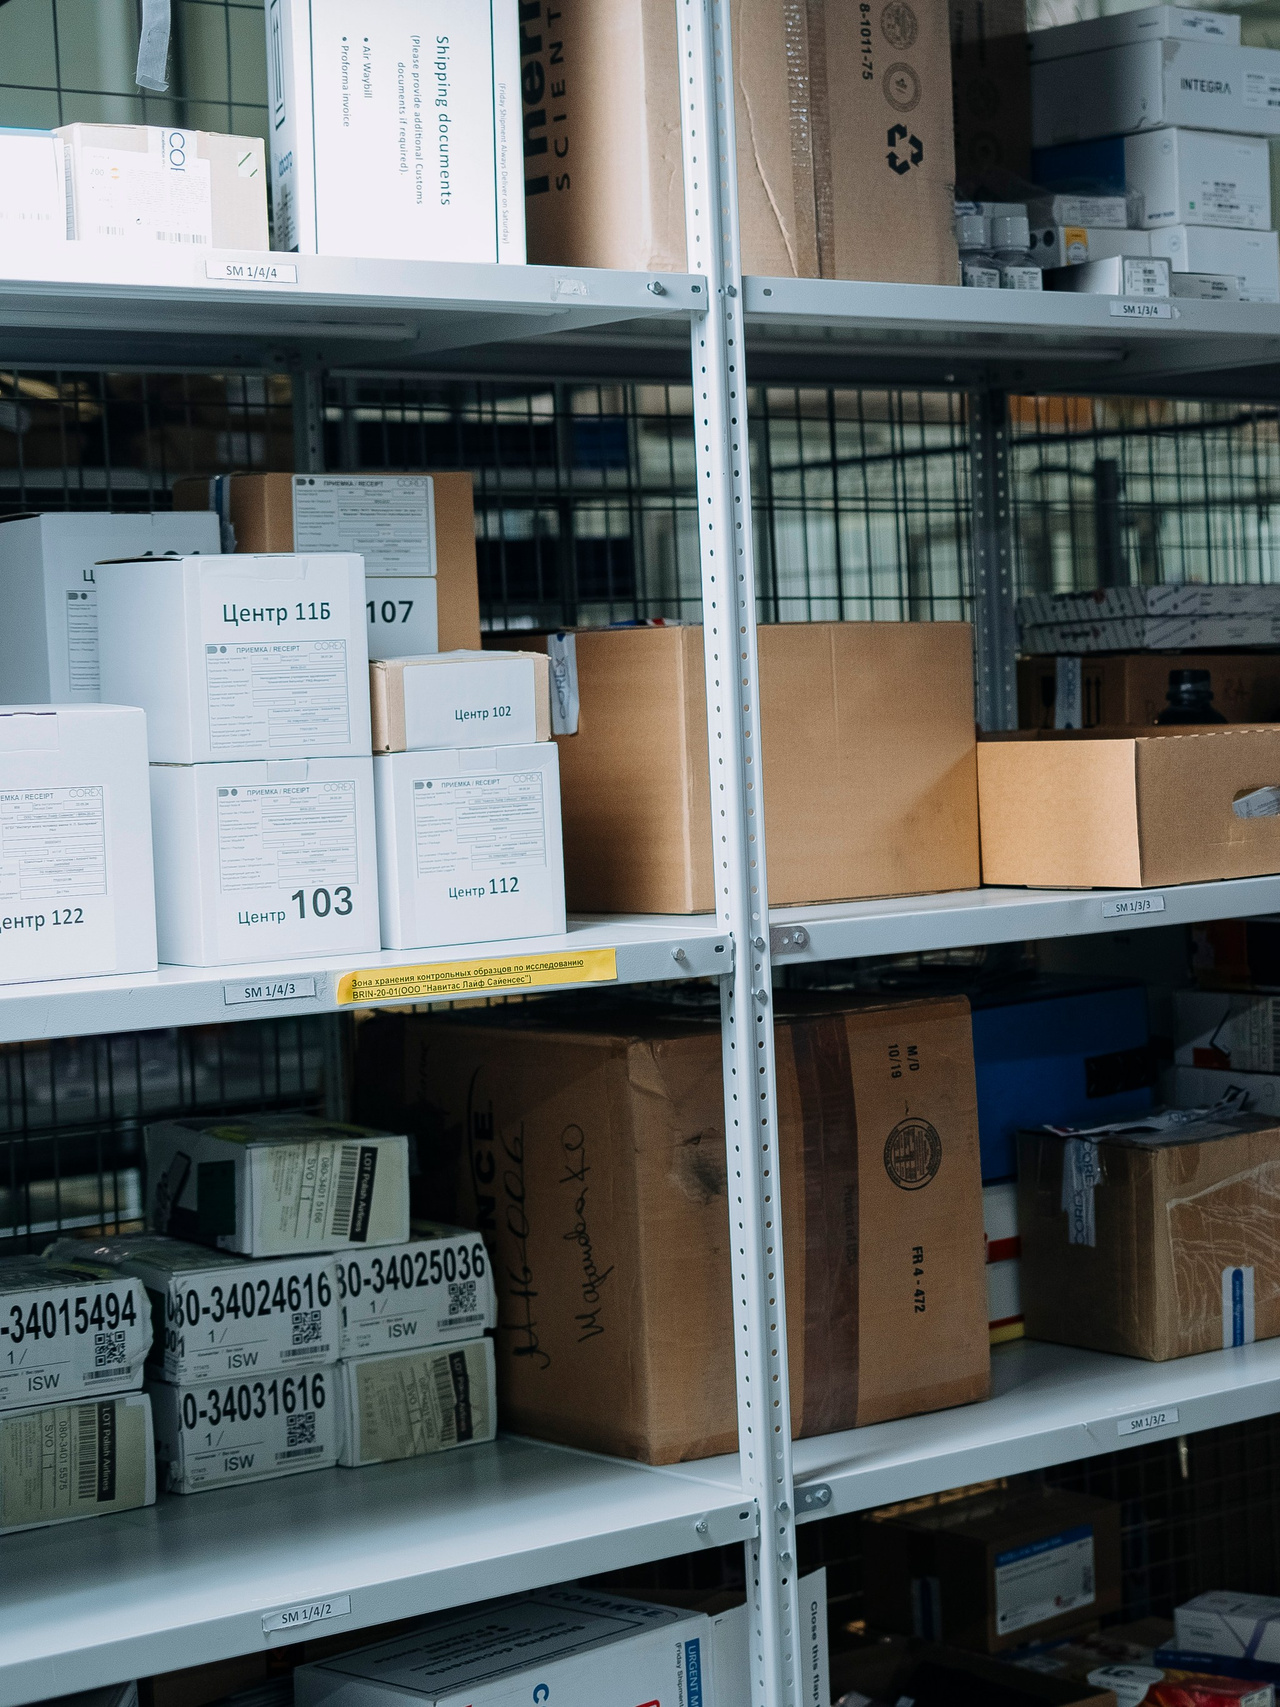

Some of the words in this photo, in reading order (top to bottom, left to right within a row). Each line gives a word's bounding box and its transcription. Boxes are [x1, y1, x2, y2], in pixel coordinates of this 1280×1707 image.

[363, 46, 371, 61] Air
[410, 35, 421, 69] (Please
[341, 45, 350, 91] Proforma
[362, 63, 372, 98] Waybill
[434, 36, 450, 107] Shipping
[398, 62, 406, 115] documents
[411, 72, 421, 109] provide
[1180, 78, 1232, 95] INTEGRA
[342, 93, 351, 127] invoice
[413, 112, 423, 161] additional
[400, 127, 409, 175] required).
[438, 114, 452, 206] documents
[500, 144, 508, 169] Always
[415, 163, 424, 205] Customs
[502, 198, 508, 208] on
[225, 265, 244, 278] SM
[247, 265, 278, 279] 1/4/4
[1123, 304, 1136, 315] SM
[1138, 305, 1159, 316] 1/3/4
[222, 602, 288, 625] Центр
[368, 600, 414, 624] 107
[455, 707, 489, 723] Центр
[492, 706, 512, 719] 102
[448, 886, 486, 900] Центр
[489, 876, 520, 895] 112
[238, 910, 286, 926] Центр
[291, 886, 353, 919] 103
[1115, 902, 1127, 913] SM
[1129, 899, 1151, 911] 1/3/3
[0, 912, 45, 934] ентр
[52, 908, 84, 926] 122
[351, 978, 374, 988] Зона
[377, 974, 415, 986] хранения
[417, 970, 472, 983] контрольных
[473, 967, 512, 980] образцов
[514, 965, 524, 976] по
[526, 957, 584, 974] исследованию
[244, 986, 262, 999] SM
[265, 983, 296, 998] 1/4/3
[423, 981, 460, 995] "Навитас
[462, 979, 485, 992] Лайф
[888, 1043, 902, 1079] 10/19
[305, 1158, 317, 1181] SVO
[363, 1152, 373, 1171] LOT
[360, 1173, 370, 1201] Polish
[911, 1246, 924, 1265] FR
[914, 1288, 926, 1313] 472
[388, 1321, 418, 1338] ISW
[228, 1352, 259, 1369] ISW
[28, 1373, 60, 1391] ISW
[179, 1372, 326, 1430] 0-34031616
[102, 1407, 111, 1426] LOT
[1131, 1418, 1143, 1429] SM
[1144, 1414, 1166, 1427] 1/3/2
[44, 1424, 54, 1448] SVO
[59, 1420, 68, 1465] 080-3401
[102, 1429, 111, 1456] Polish
[224, 1453, 255, 1471] ISW
[102, 1459, 111, 1491] Airlines
[281, 1611, 299, 1624] SM
[301, 1604, 332, 1620] 1/4/2
[675, 1642, 683, 1669] (Friday
[687, 1645, 700, 1693] URGENT
